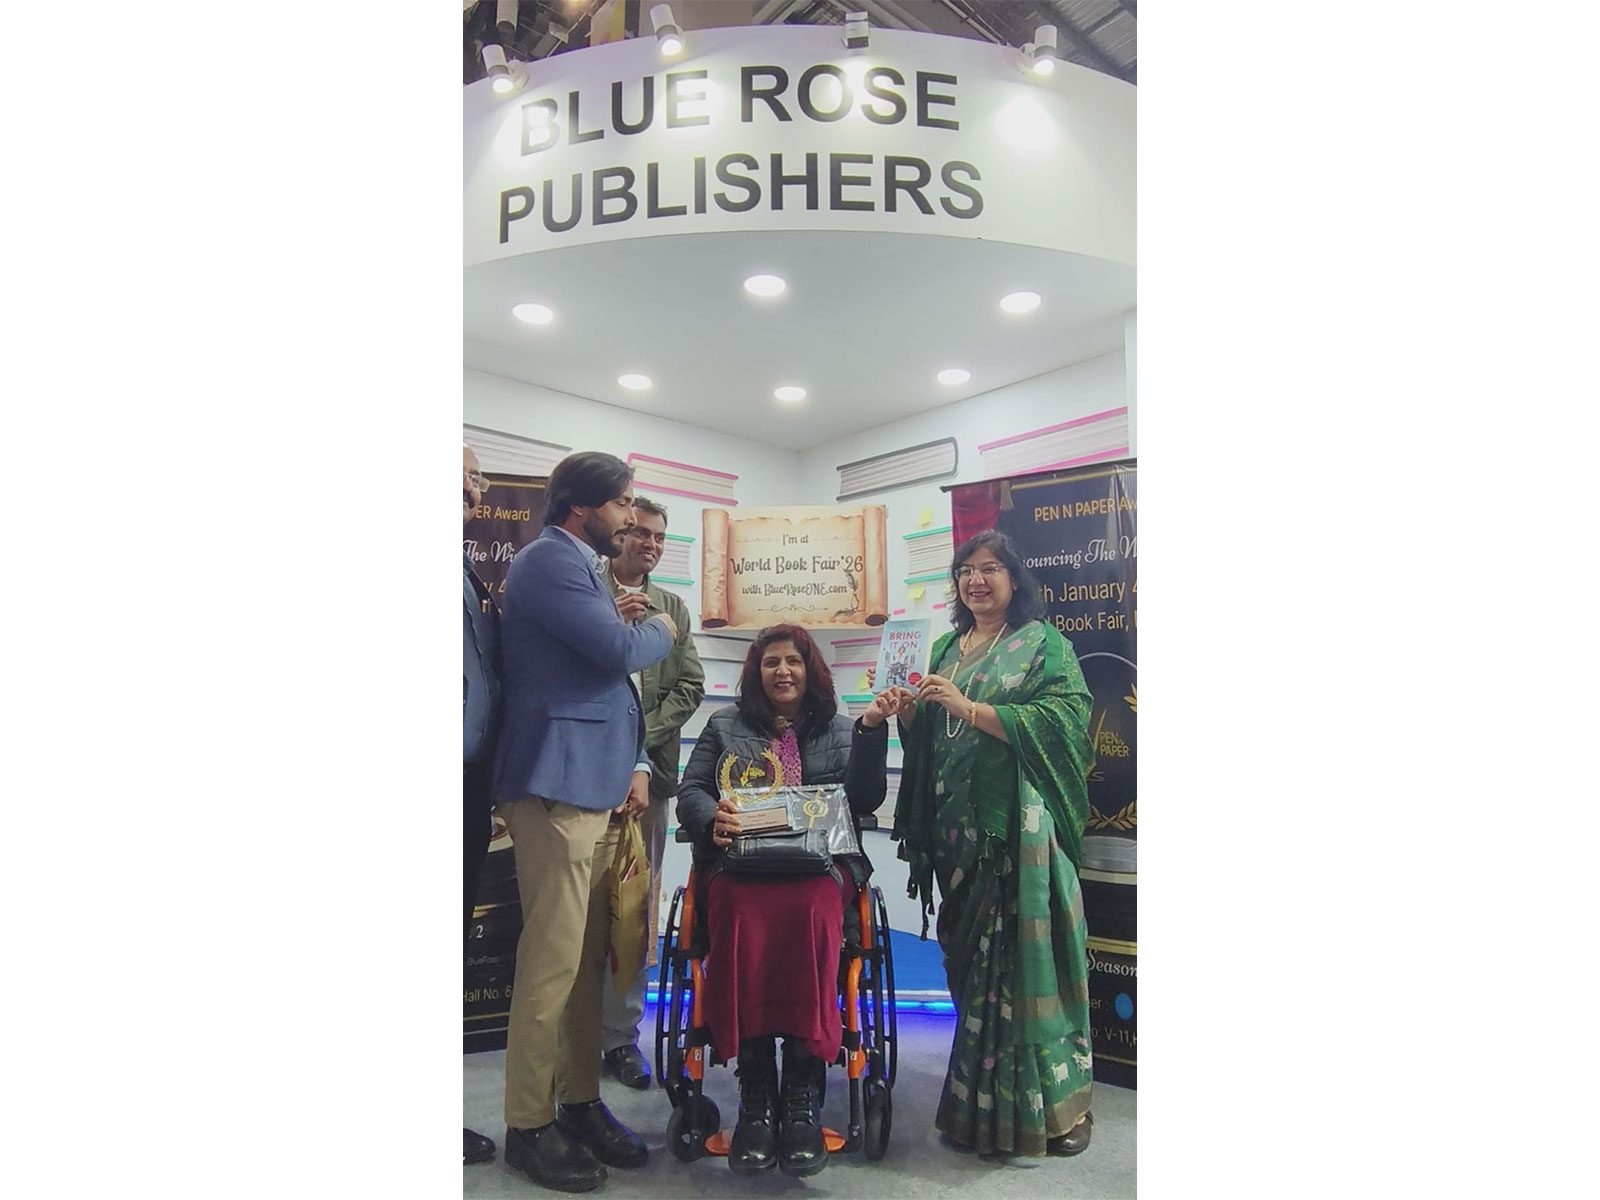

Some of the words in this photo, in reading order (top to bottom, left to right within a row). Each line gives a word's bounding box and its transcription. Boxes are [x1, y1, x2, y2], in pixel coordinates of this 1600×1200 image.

[520, 69, 710, 156] BLUE
[740, 64, 960, 131] ROSE
[499, 152, 984, 244] PUBLISHERS
[493, 506, 530, 522] Award
[1034, 505, 1059, 522] PEN
[1062, 503, 1072, 519] N
[1075, 497, 1116, 517] PAPER
[782, 533, 798, 546] I'm
[800, 534, 809, 544] at
[1023, 549, 1082, 569] ouncing
[1084, 538, 1116, 563] The
[729, 557, 771, 575] World
[775, 556, 808, 574] Book
[742, 584, 761, 595] with
[764, 583, 847, 596] BlueRoseONE.com
[1059, 581, 1126, 603] January
[1055, 613, 1094, 632] Book
[1097, 610, 1129, 633] Fair,
[889, 630, 922, 641] BRING
[890, 641, 899, 649] IT
[901, 640, 918, 649] ON
[1100, 731, 1119, 744] PEN
[1100, 744, 1130, 757] PAPER
[475, 924, 484, 938] 2
